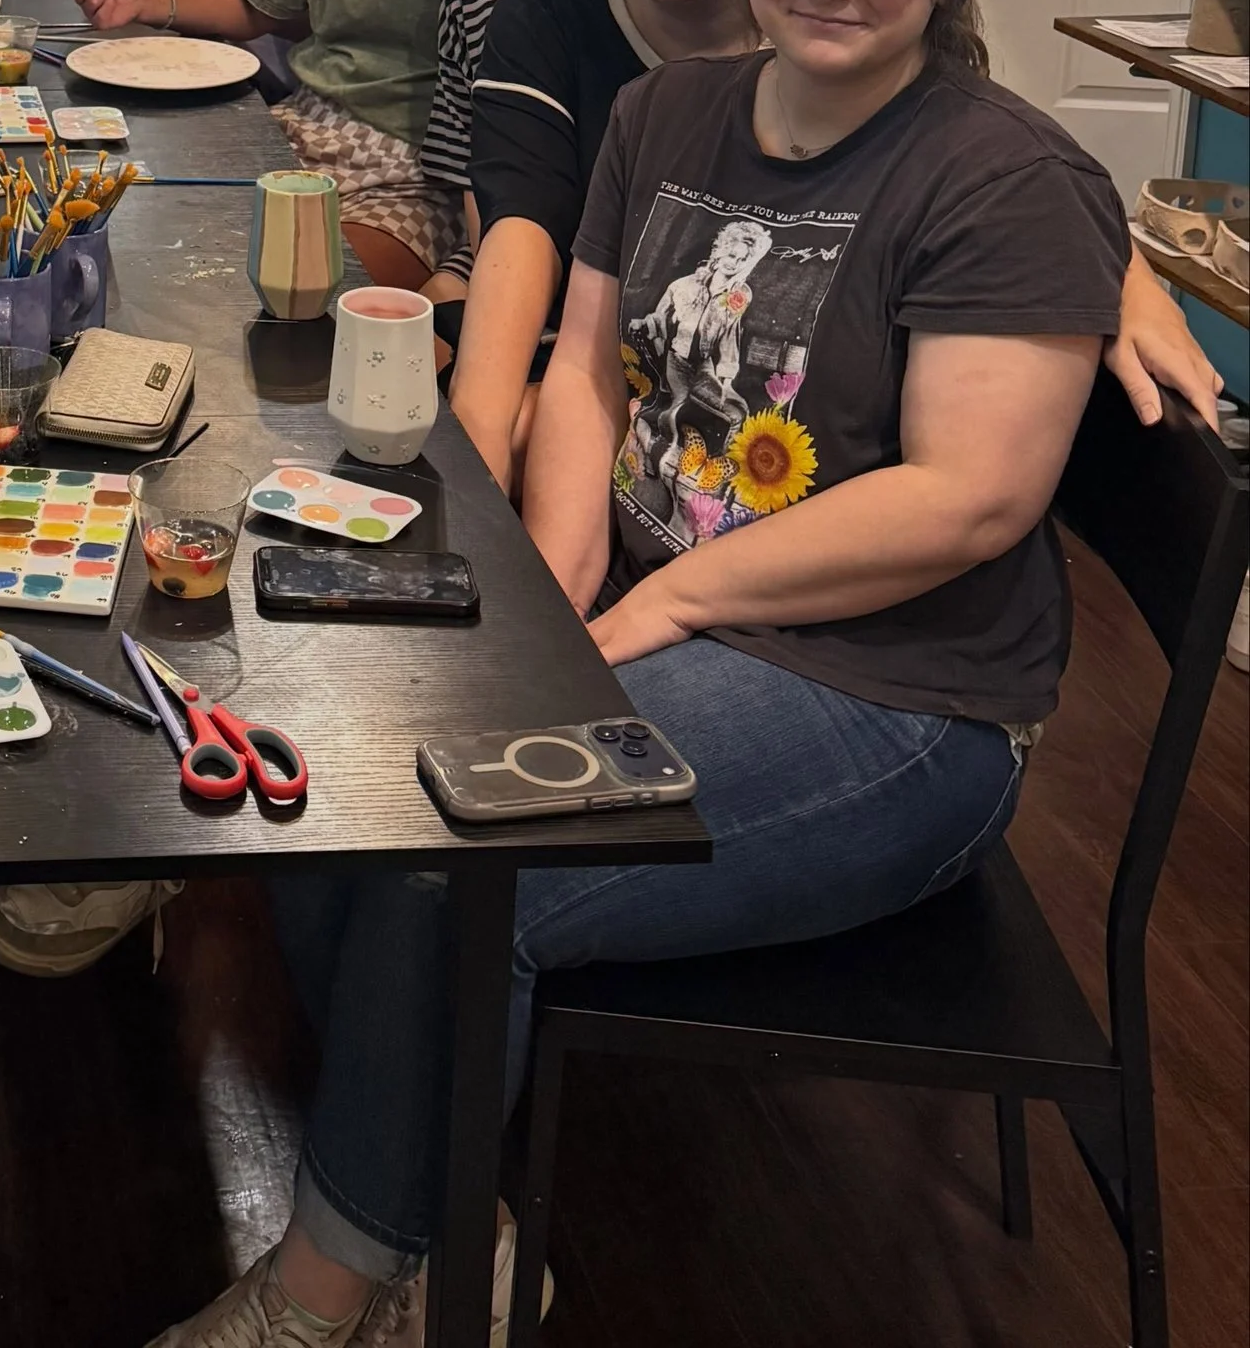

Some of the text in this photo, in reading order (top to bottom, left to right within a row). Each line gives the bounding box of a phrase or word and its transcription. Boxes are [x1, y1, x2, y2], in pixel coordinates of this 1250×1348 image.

[660, 181, 680, 193] THE
[681, 187, 698, 200] WAY
[703, 193, 725, 210] SEE
[753, 205, 775, 219] YOU
[818, 210, 861, 221] RAINBOW
[616, 492, 639, 516] GOTTA
[636, 513, 654, 528] PUT
[651, 526, 664, 537] UP
